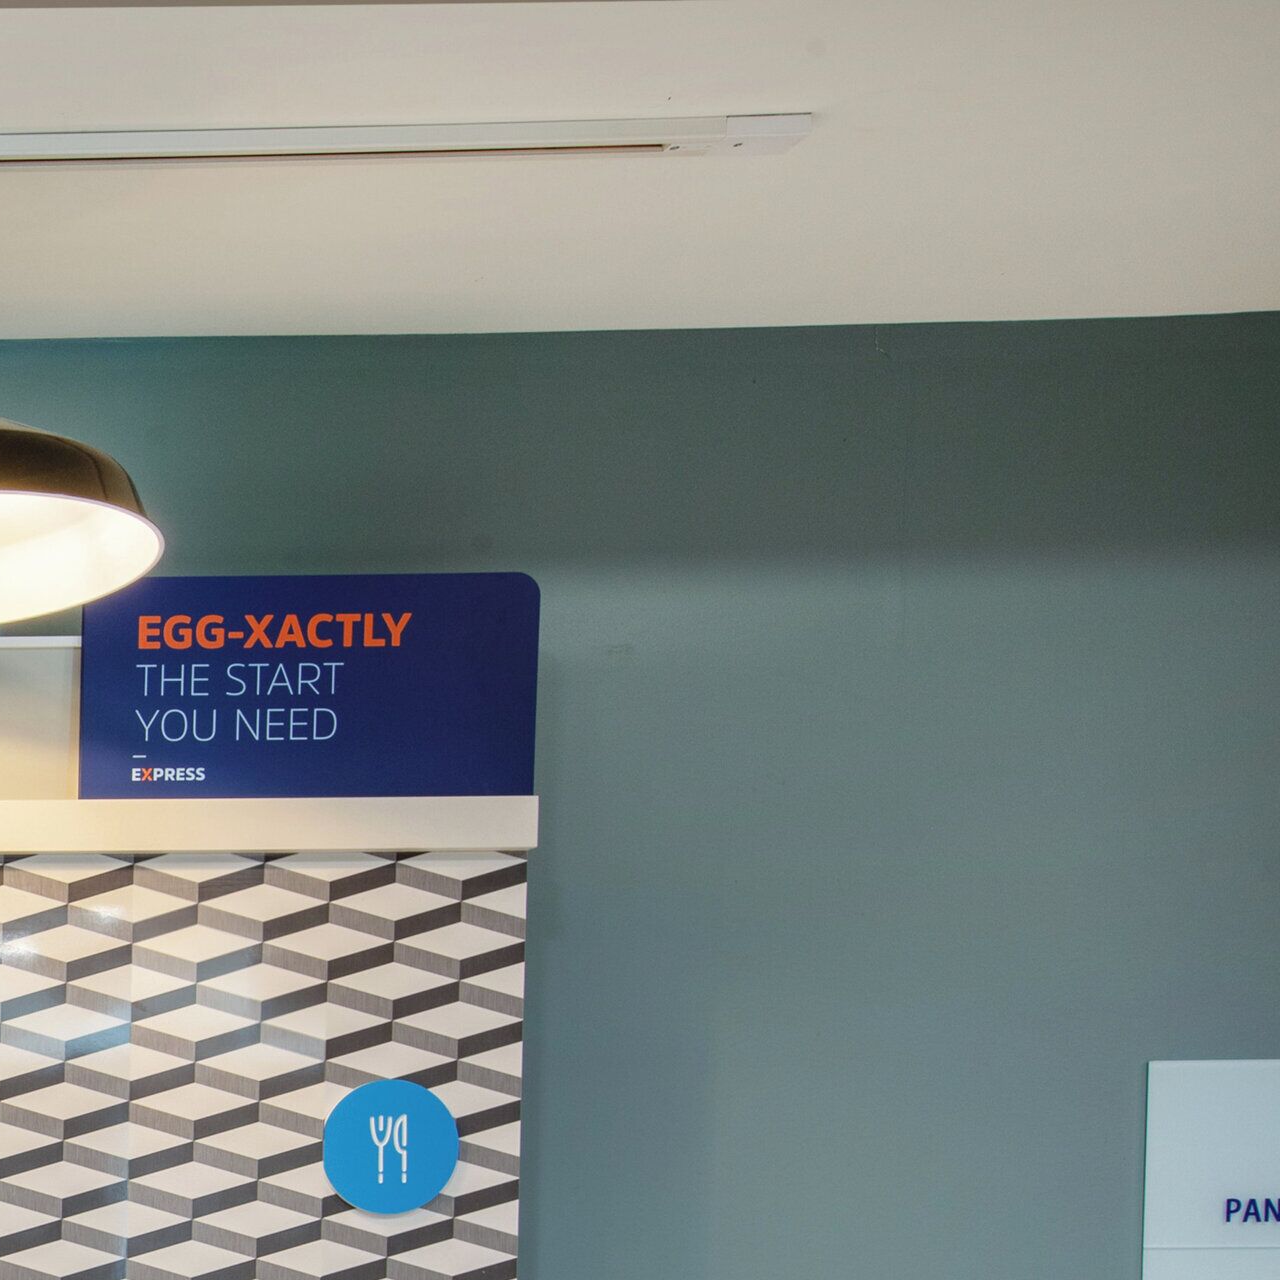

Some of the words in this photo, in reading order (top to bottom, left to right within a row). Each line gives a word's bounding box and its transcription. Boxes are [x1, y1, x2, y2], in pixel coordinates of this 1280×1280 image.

[137, 612, 412, 650] EGG-XACTLY
[135, 662, 210, 697] THE
[225, 662, 345, 697] START
[135, 708, 217, 742] YOU
[235, 707, 338, 741] NEED
[131, 767, 206, 782] EXPRESS
